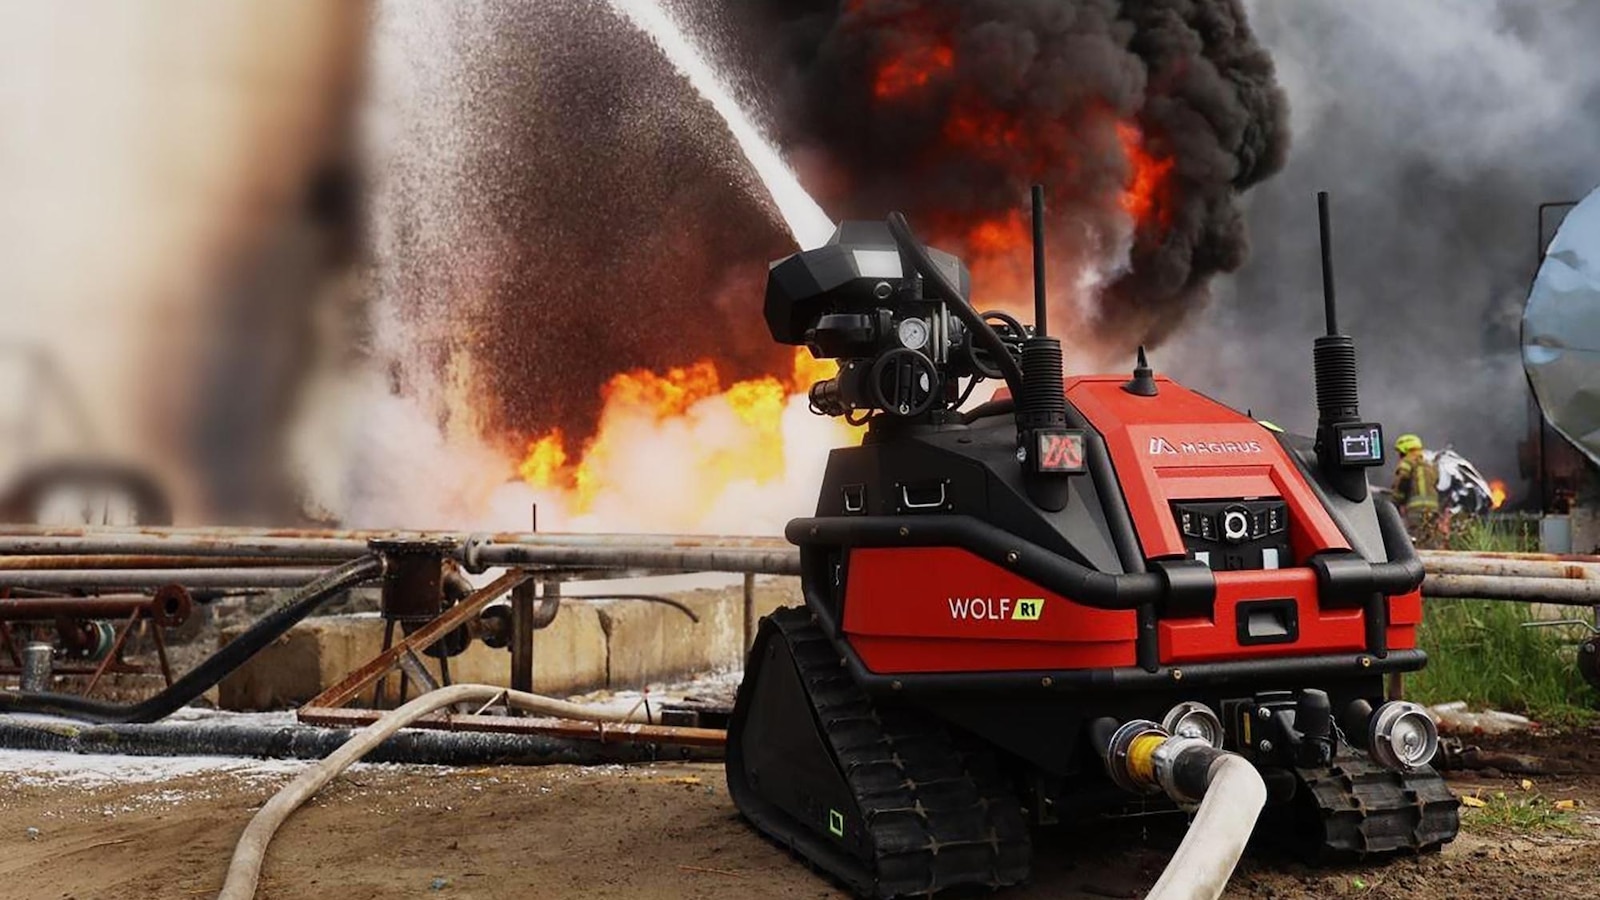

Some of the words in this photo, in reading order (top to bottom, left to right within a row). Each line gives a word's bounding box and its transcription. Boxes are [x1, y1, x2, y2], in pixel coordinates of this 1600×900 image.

[1181, 441, 1262, 454] MAGIRUS
[948, 598, 1010, 620] WOLF
[1020, 602, 1036, 617] R1
